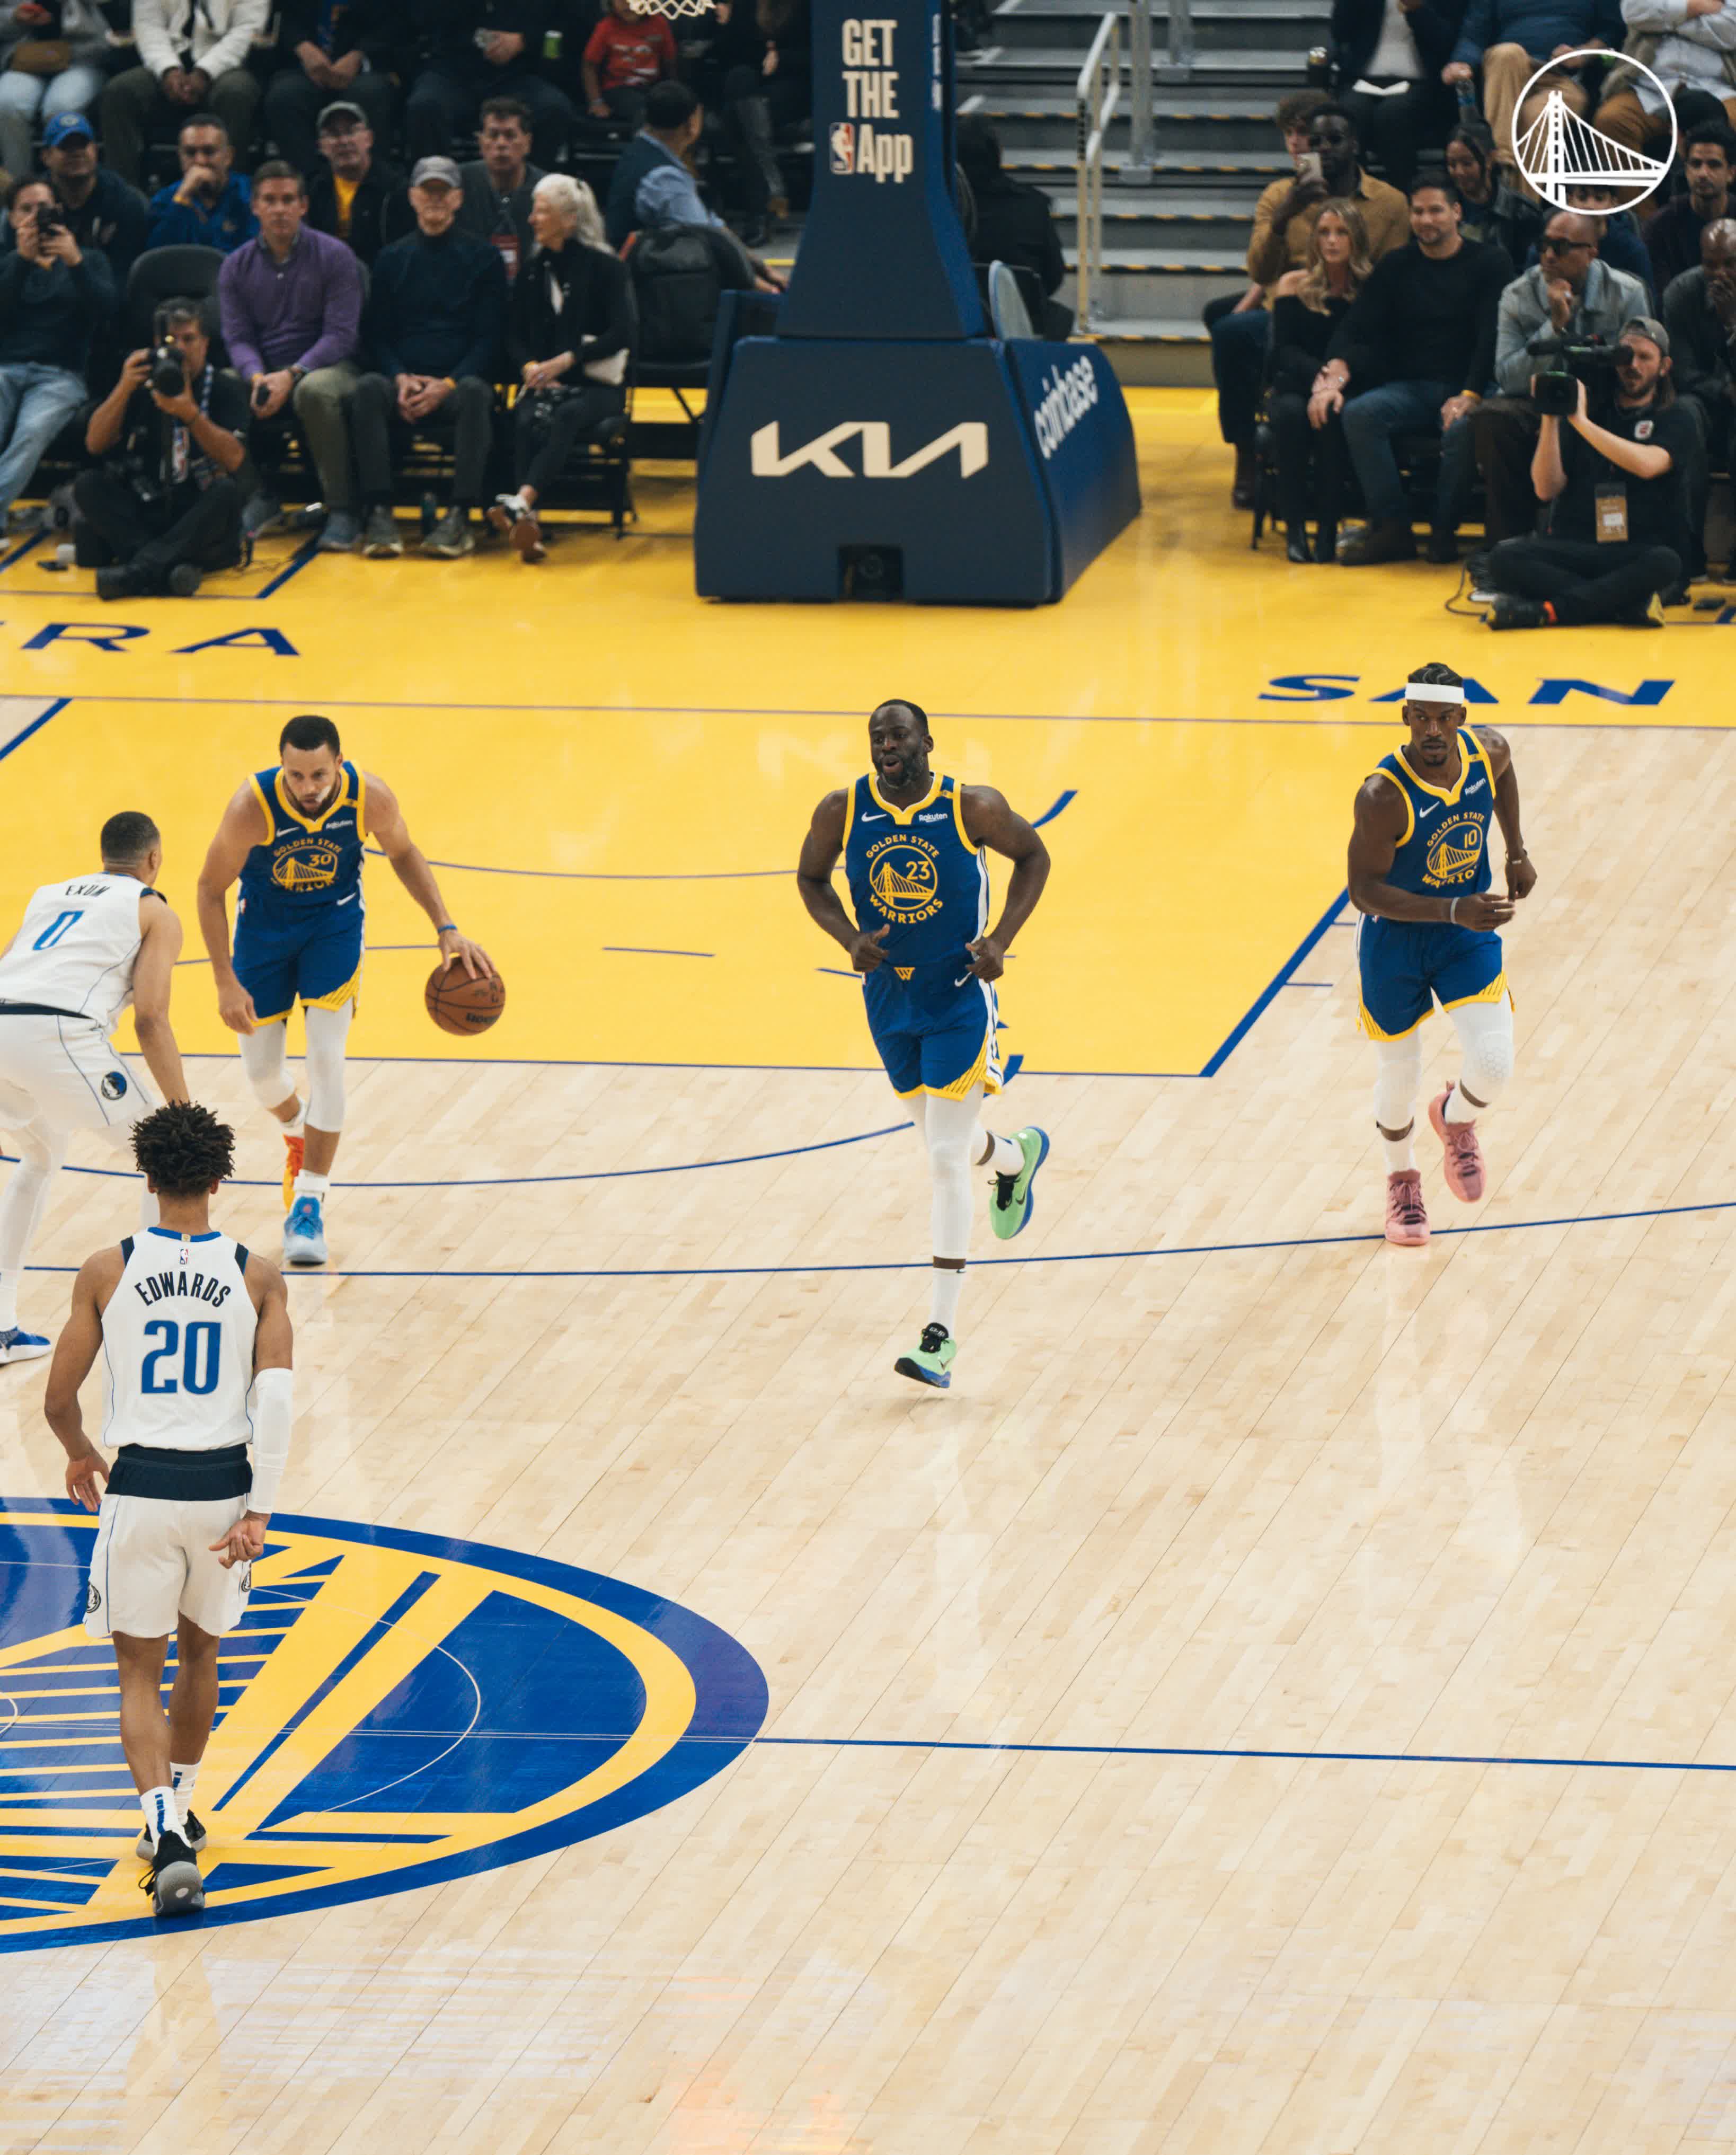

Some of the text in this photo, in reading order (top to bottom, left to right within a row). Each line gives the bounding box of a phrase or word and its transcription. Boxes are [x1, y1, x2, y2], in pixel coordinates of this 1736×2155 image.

[842, 18, 898, 67] GET
[842, 70, 899, 118] THE
[856, 123, 914, 183] App
[1034, 355, 1098, 460] coinbase
[0, 621, 300, 657] RA
[1257, 674, 1676, 706] SAN
[918, 812, 949, 823] Rakuten
[1427, 811, 1484, 847] GOLDEN STATE
[273, 837, 314, 857] GOLDEN
[865, 834, 940, 858] GOLDEN STATE
[1464, 829, 1477, 849] 10
[308, 853, 332, 867] 30
[906, 860, 931, 880] 23
[870, 893, 944, 924] WARRIORS
[32, 910, 85, 951] 0
[134, 1271, 232, 1308] EDWARDS
[141, 1319, 222, 1395] 20
